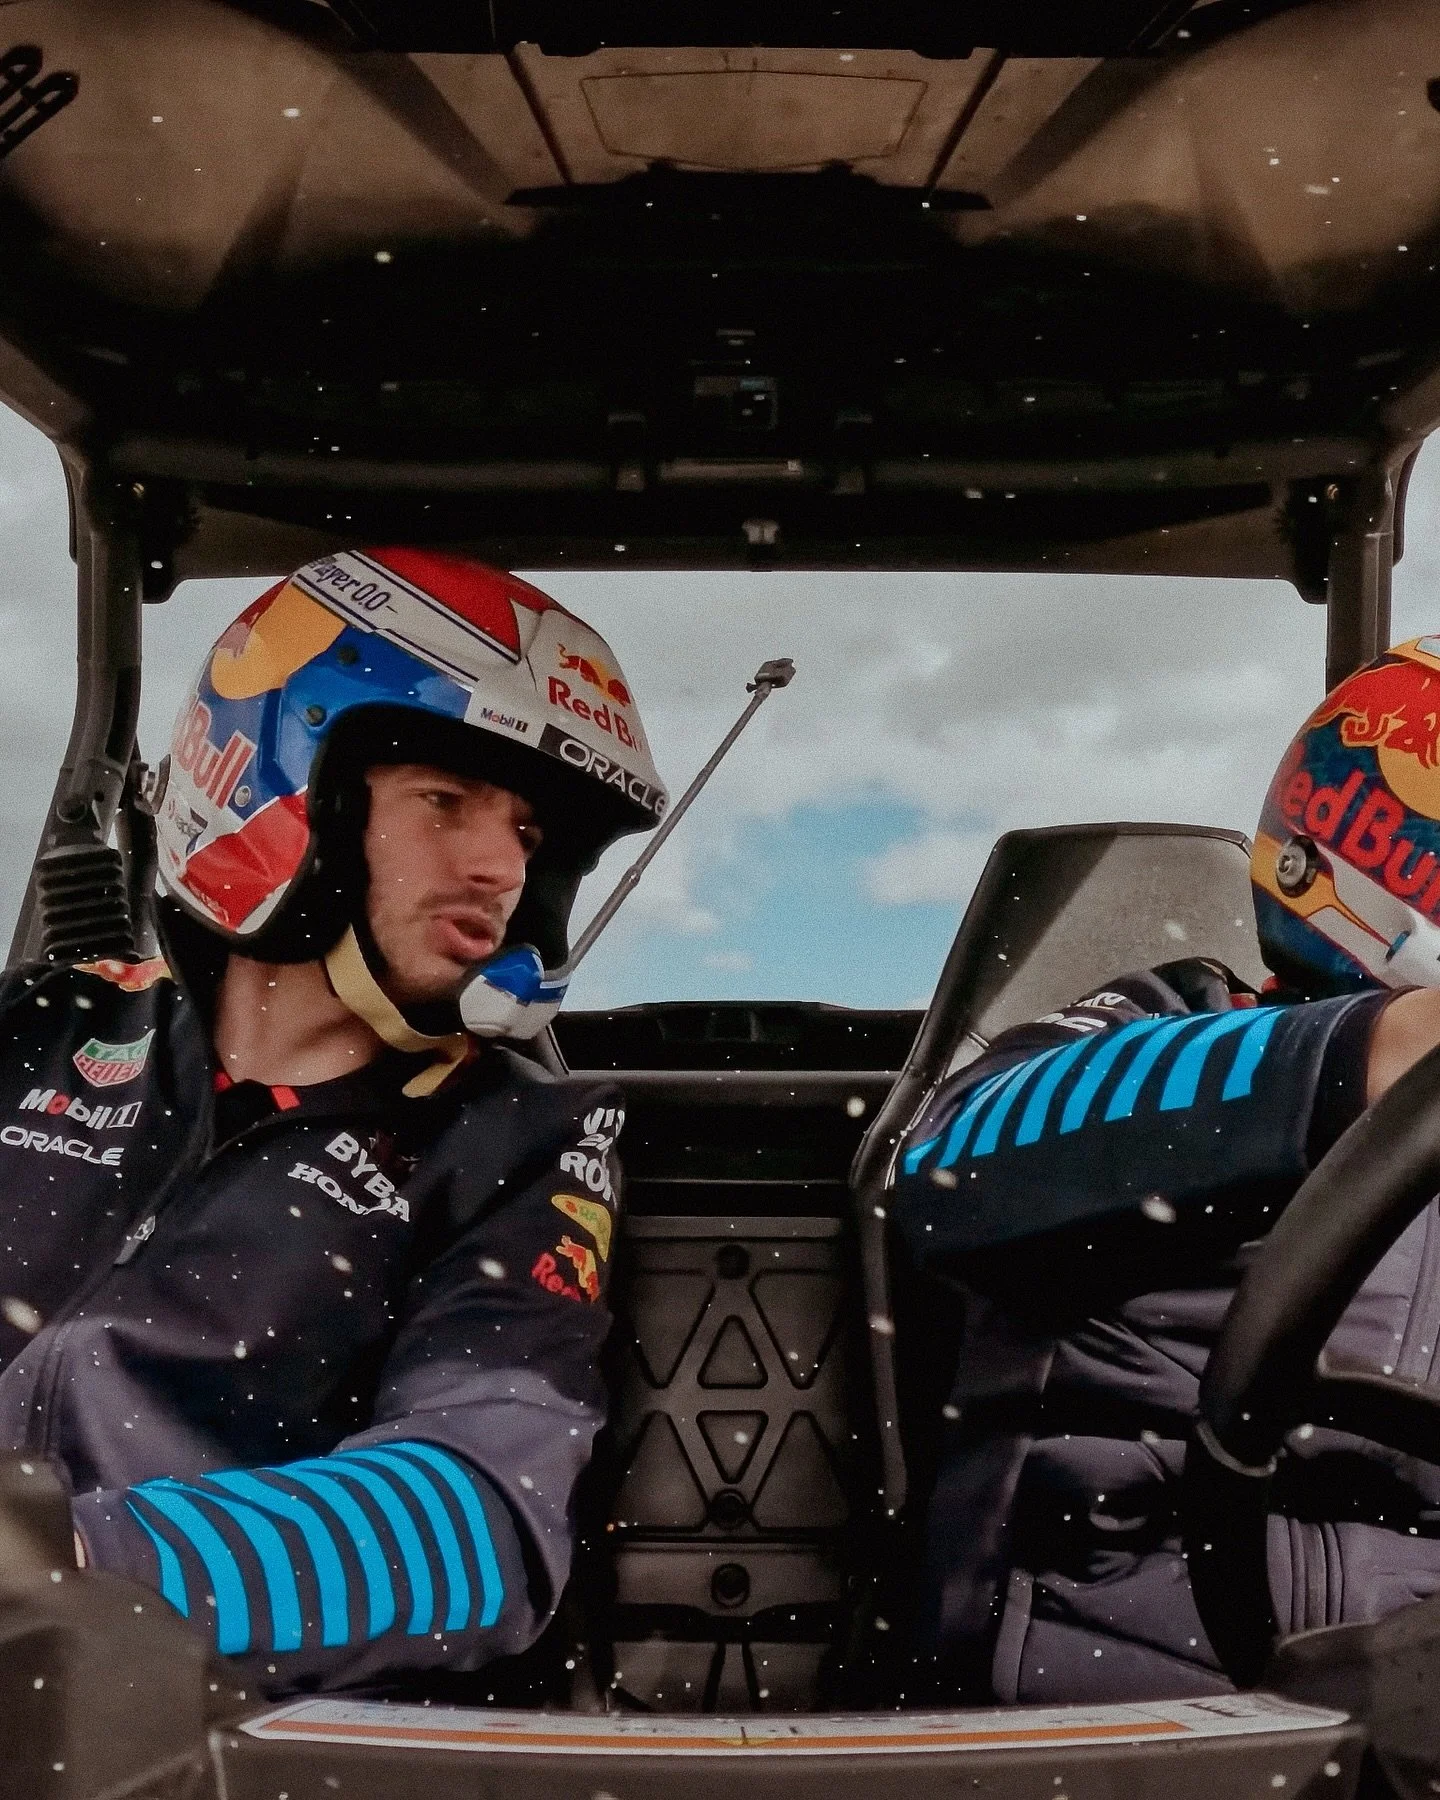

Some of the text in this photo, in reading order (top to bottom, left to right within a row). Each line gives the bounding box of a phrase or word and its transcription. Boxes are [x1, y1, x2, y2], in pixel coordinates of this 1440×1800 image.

[481, 707, 515, 728] Mobil
[547, 676, 613, 735] Red
[19, 1089, 142, 1130] Mobil 1
[0, 1126, 124, 1166] ORACLE
